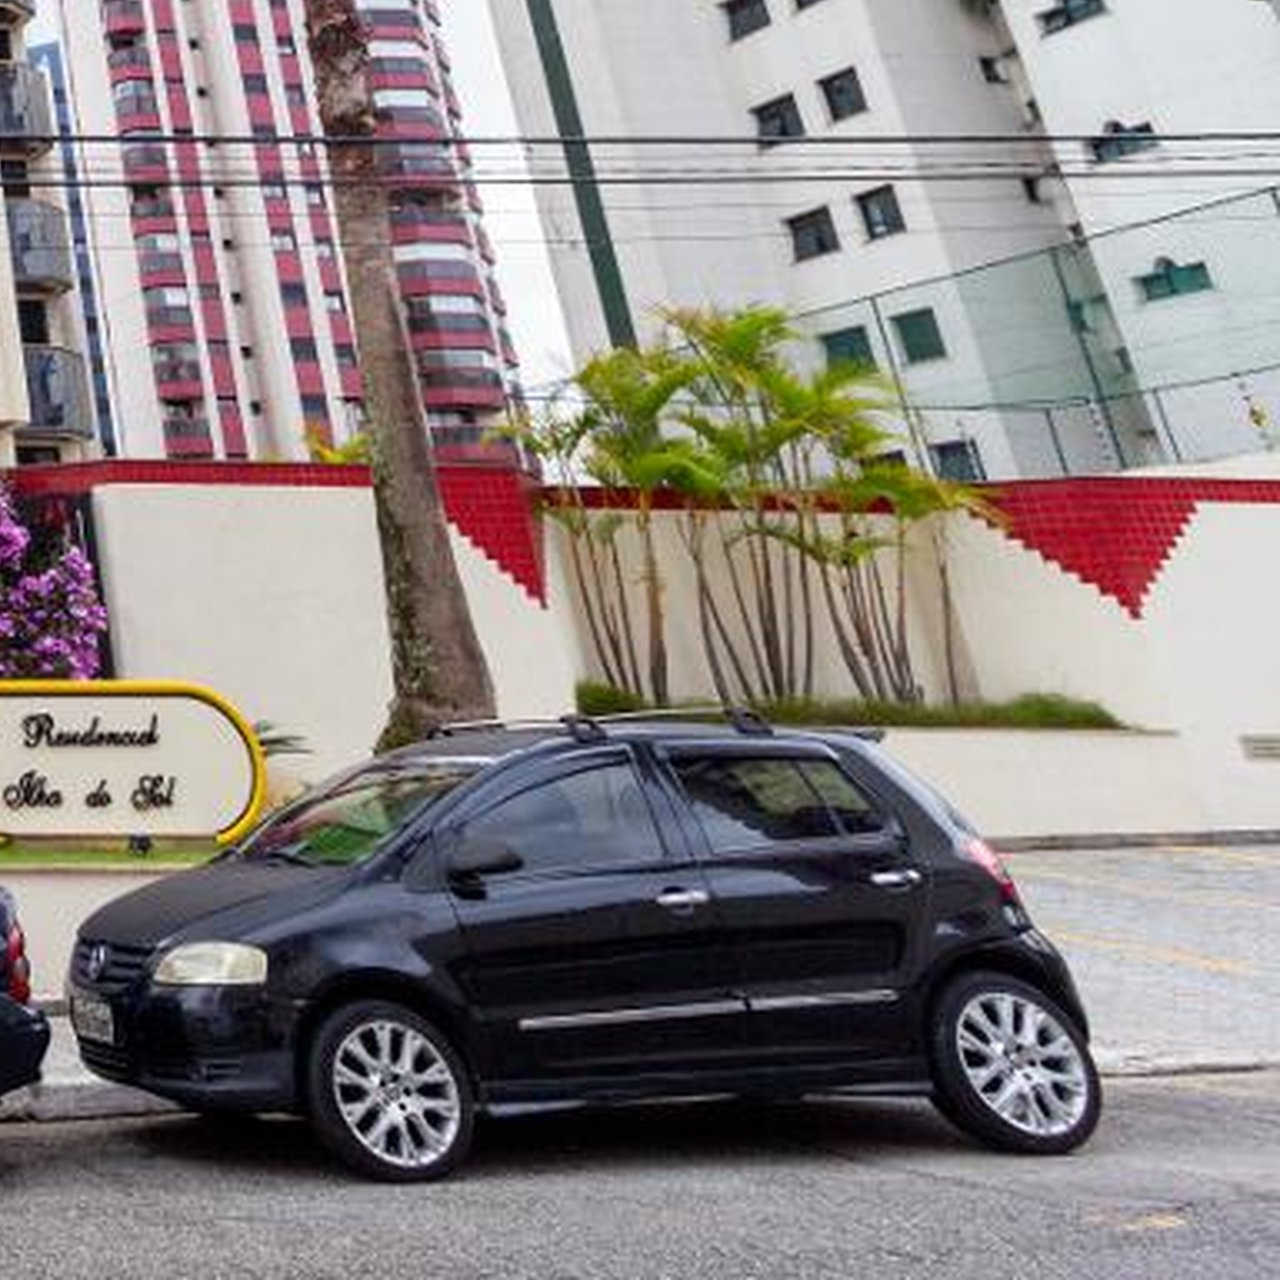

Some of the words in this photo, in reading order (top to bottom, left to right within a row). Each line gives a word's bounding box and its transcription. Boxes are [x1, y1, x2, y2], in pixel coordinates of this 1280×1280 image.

[2, 770, 63, 810] Ilha
[85, 779, 112, 808] do
[130, 775, 176, 811] Sol
